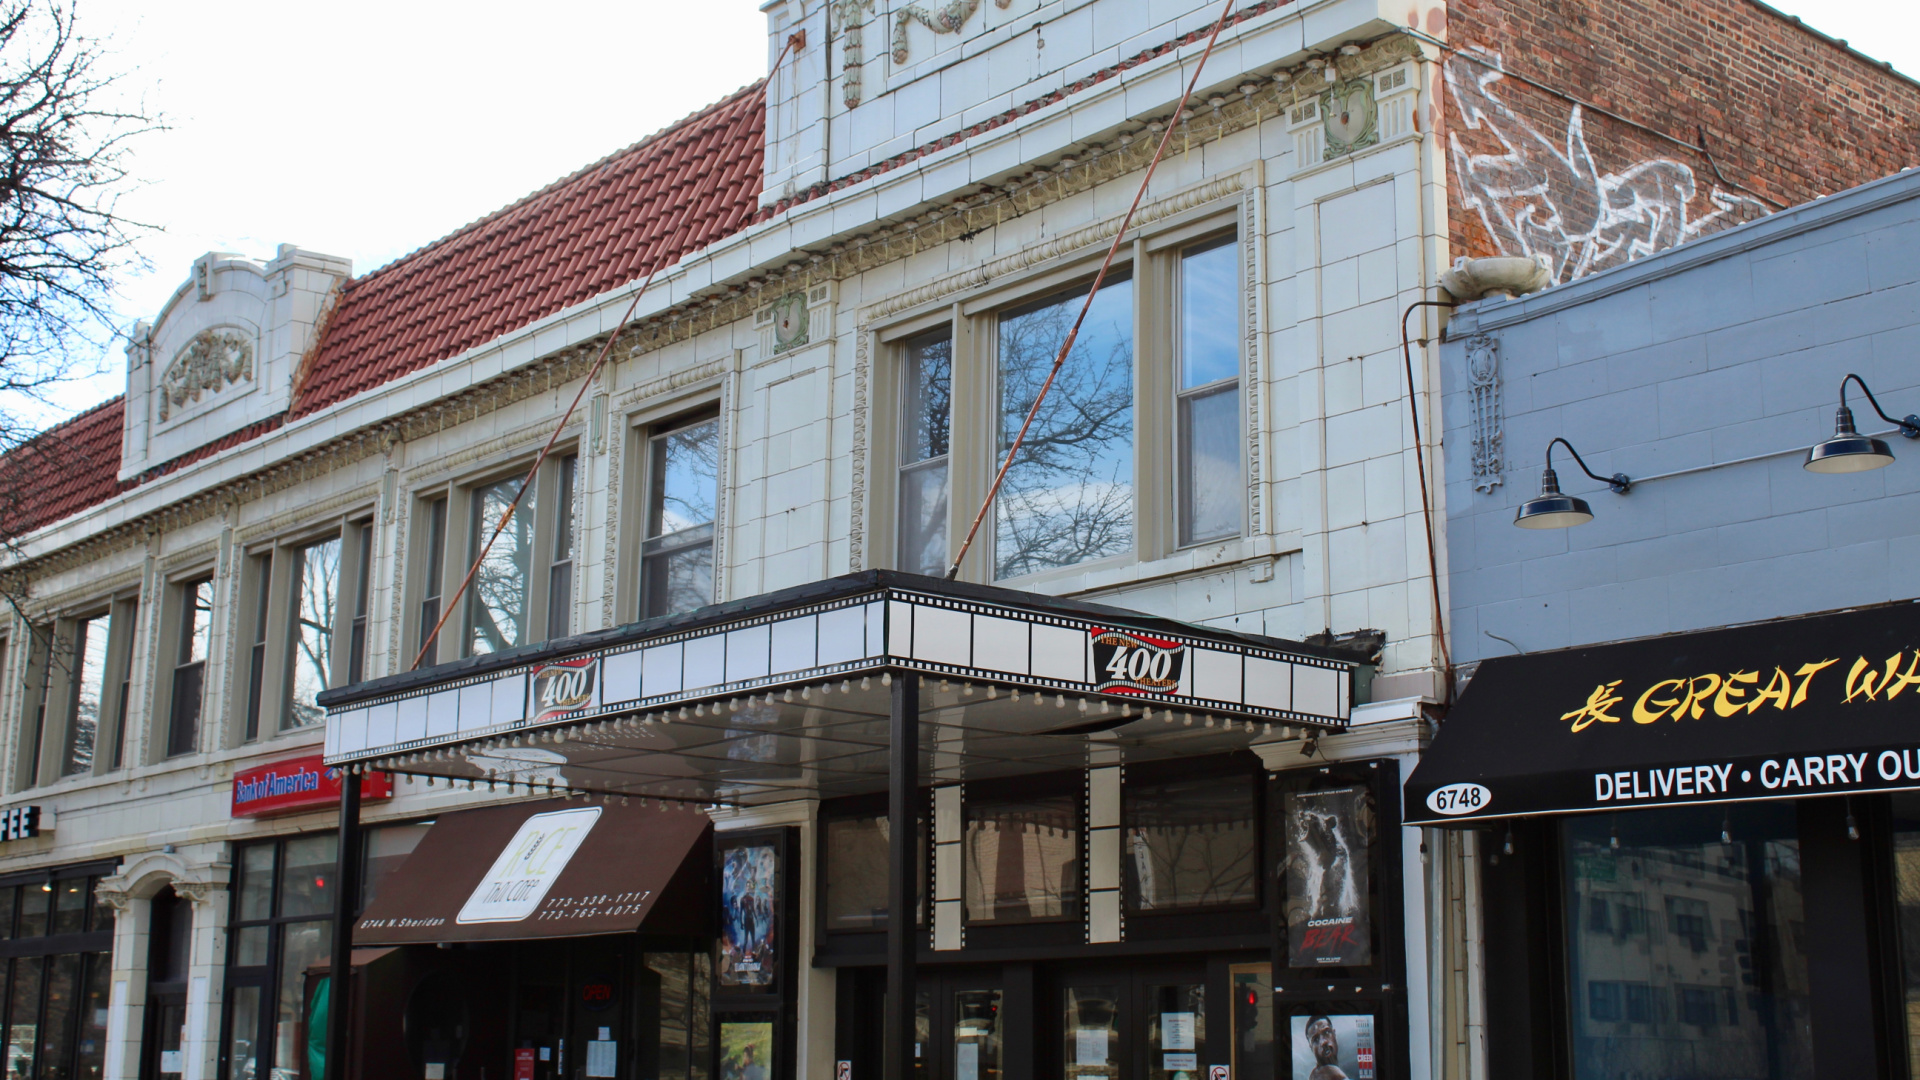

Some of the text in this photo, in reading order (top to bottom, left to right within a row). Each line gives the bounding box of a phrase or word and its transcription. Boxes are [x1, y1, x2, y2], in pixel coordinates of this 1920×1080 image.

[1101, 636, 1138, 649] THE NEW
[1106, 646, 1172, 682] 400
[541, 668, 587, 707] 400
[1134, 677, 1177, 687] THEATERS
[1631, 658, 1840, 724] GREAT
[236, 767, 319, 804] Bank of America
[1595, 763, 1733, 801] DELIVERY
[1760, 752, 1868, 789] CARRY
[1436, 787, 1482, 810] 6748
[0, 806, 31, 842] FEE
[547, 890, 651, 908] 773-338-1717
[360, 919, 386, 929] 6744
[398, 917, 446, 928] Sheridan
[538, 904, 641, 920] 773-765-4075
[1307, 916, 1353, 927] COCAINE
[1299, 924, 1360, 954] BEAR
[582, 984, 612, 1001] OPEN
